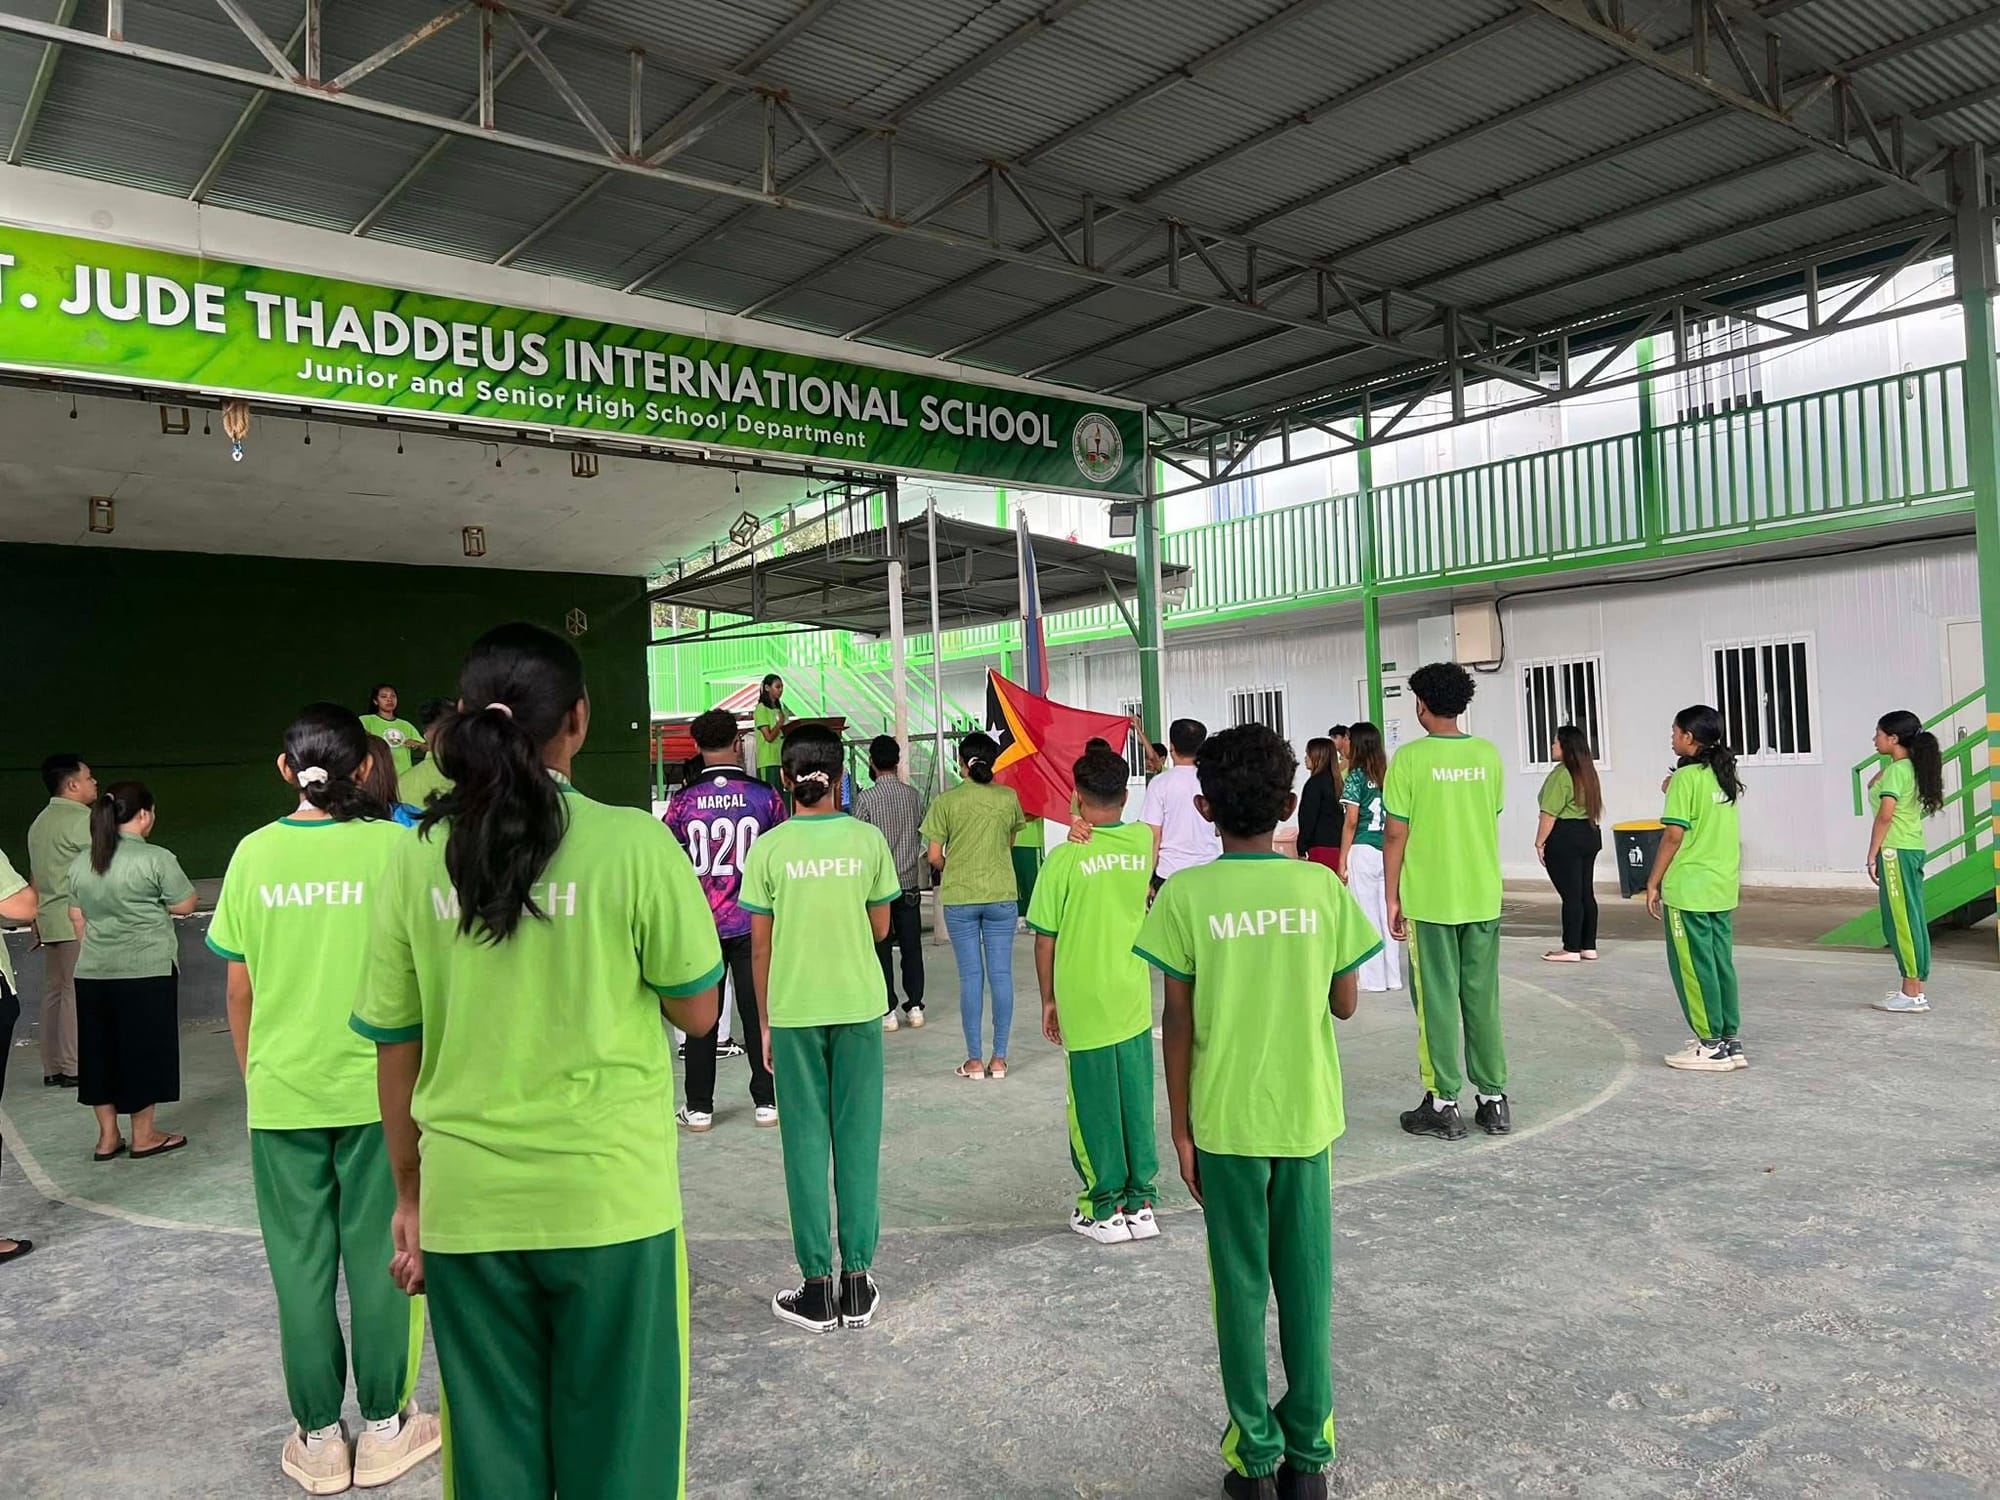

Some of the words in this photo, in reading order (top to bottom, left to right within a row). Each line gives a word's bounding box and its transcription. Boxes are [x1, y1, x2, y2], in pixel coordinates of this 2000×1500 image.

[60, 265, 226, 335] JUDE
[245, 290, 549, 377] THADDEUS
[565, 338, 908, 428] INTERNATIONAL
[919, 395, 1058, 448] SCHOOL
[298, 359, 398, 389] Junior
[410, 373, 464, 398] and
[476, 381, 566, 409] Senior
[576, 393, 635, 421] High
[645, 402, 728, 431] School
[737, 415, 867, 448] Department
[1432, 766, 1486, 783] MAPEH
[697, 793, 747, 810] MARÇAL
[1367, 797, 1387, 831] 1
[785, 857, 862, 880] MAPEH
[1079, 853, 1146, 878] MAPEH
[260, 881, 363, 909] MAPEH
[431, 882, 577, 921] MEH
[1208, 908, 1317, 940] MAPEH
